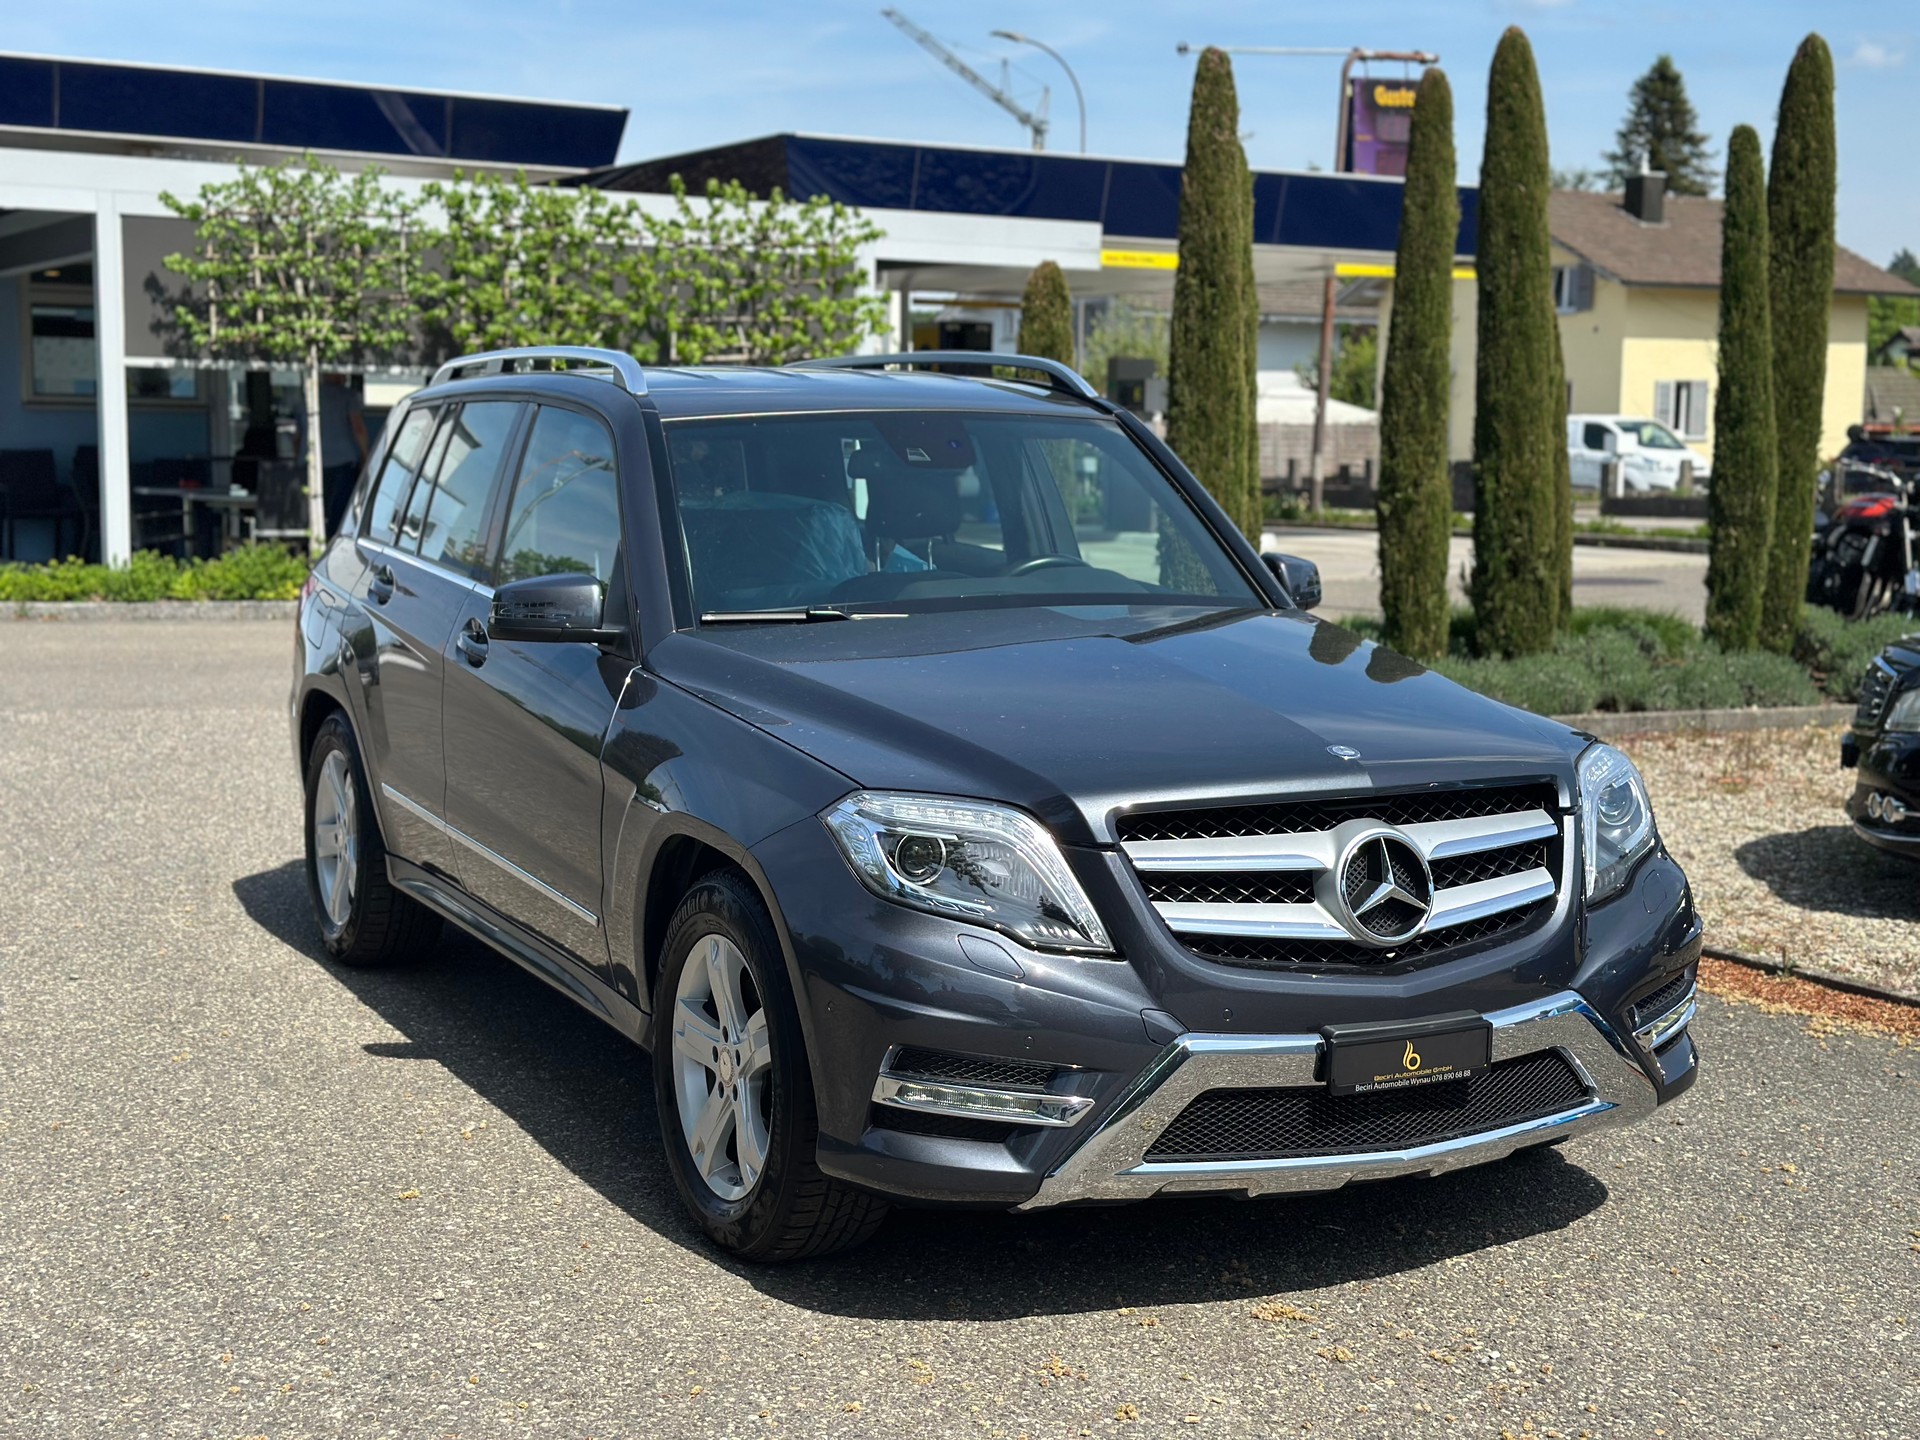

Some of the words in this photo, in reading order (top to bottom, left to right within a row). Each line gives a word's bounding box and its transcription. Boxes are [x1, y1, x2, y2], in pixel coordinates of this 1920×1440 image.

[1355, 1083, 1373, 1092] Beciri
[1373, 1079, 1410, 1090] Automobile
[1410, 1077, 1431, 1086] Wynau
[1455, 1071, 1463, 1079] 68
[1463, 1069, 1471, 1077] 88
[1374, 1073, 1394, 1082] Beciri
[1394, 1069, 1432, 1079] Automobile
[1432, 1065, 1453, 1073] GmbH
